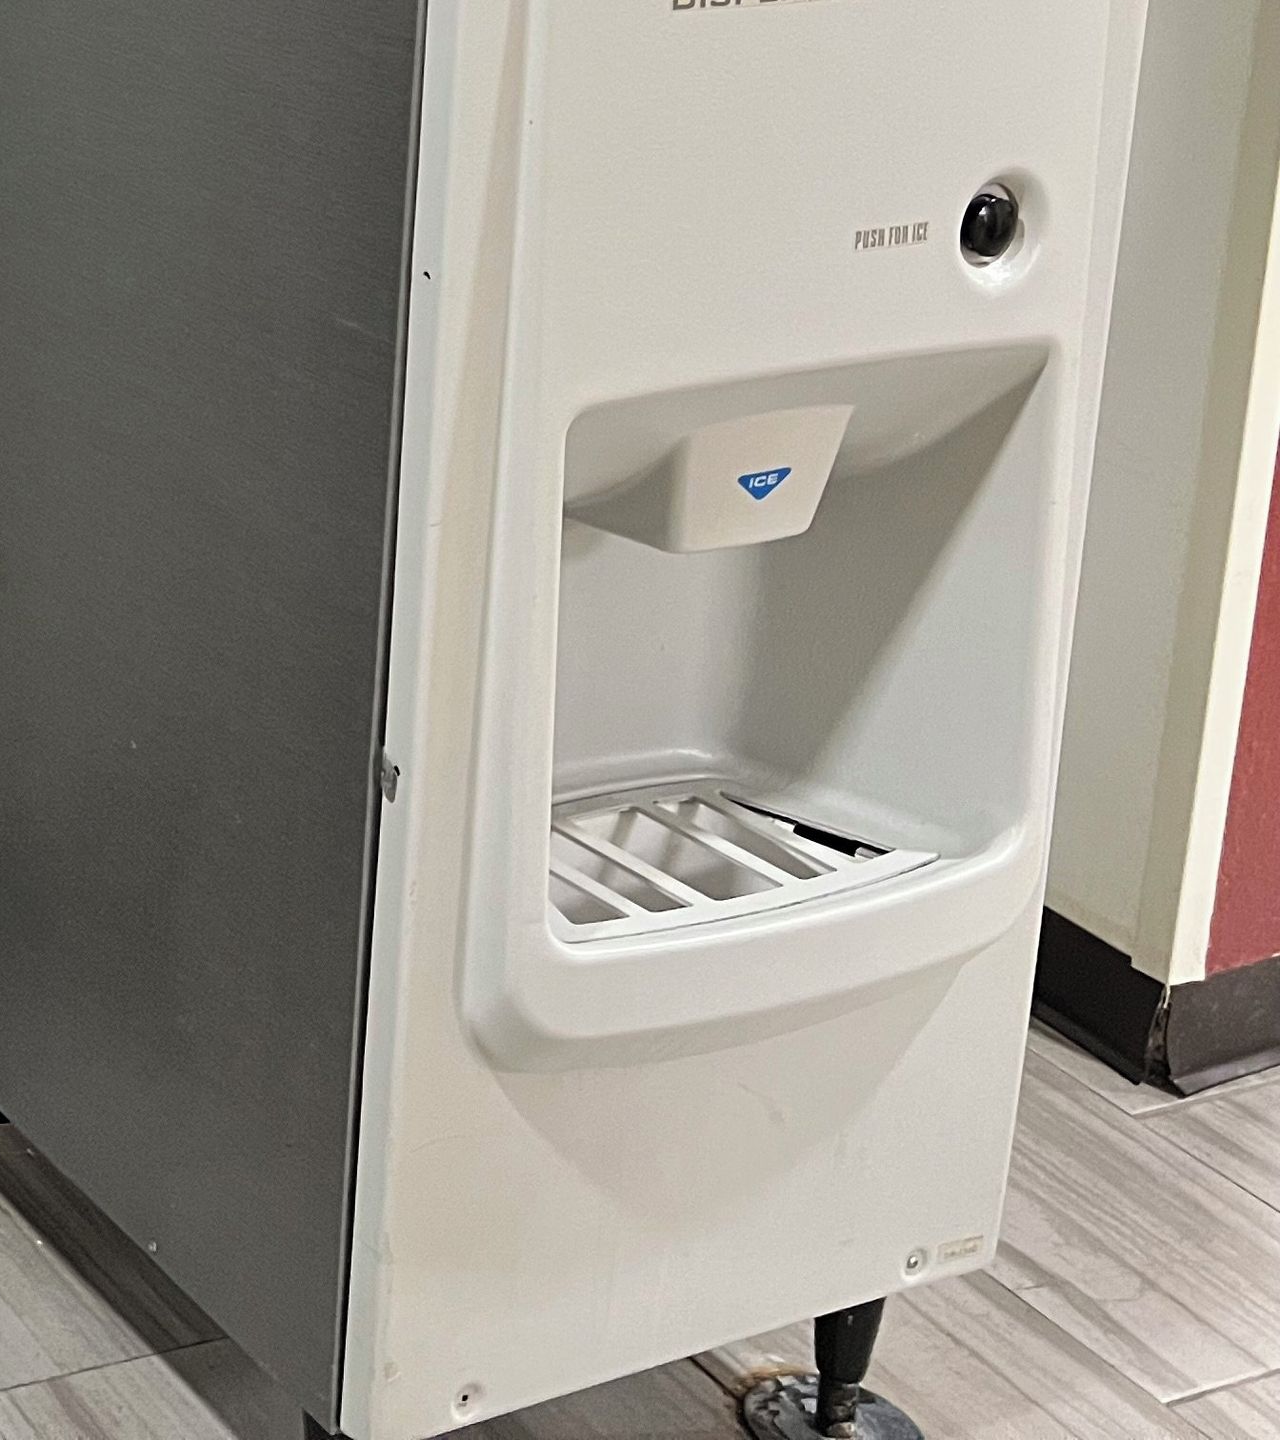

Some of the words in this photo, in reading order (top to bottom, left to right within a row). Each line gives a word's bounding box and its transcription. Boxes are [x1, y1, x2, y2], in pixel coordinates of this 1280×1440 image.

[855, 228, 885, 249] PUSH
[889, 225, 908, 246] FOR
[912, 222, 929, 243] ICE
[748, 473, 778, 488] ICE
